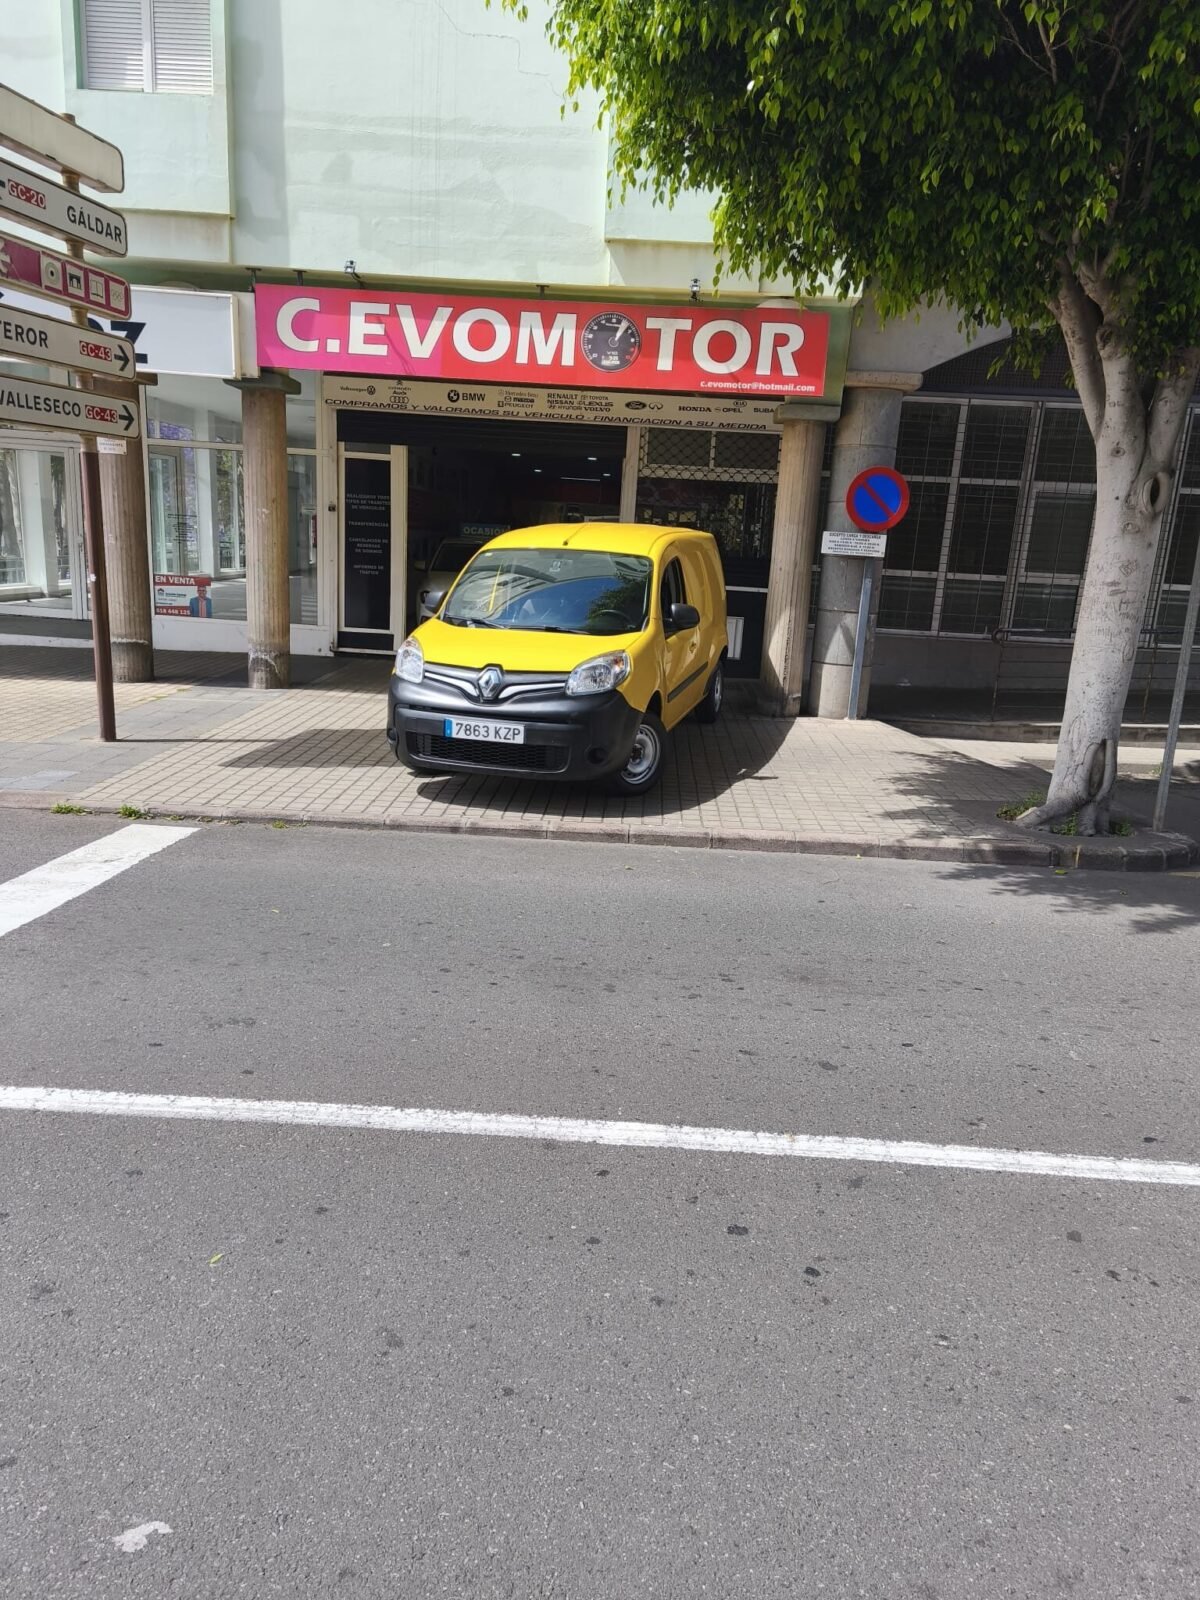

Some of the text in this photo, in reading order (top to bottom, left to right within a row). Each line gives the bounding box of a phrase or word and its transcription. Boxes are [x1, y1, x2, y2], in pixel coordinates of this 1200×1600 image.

[8, 181, 122, 244] GC-20 GÁLDAR
[0, 319, 112, 360] EROR GC-43
[700, 381, 815, 392] c.evomotor@hotmail.com
[462, 393, 485, 401] BMW
[85, 405, 118, 423] GC-43
[325, 398, 408, 410] COMPRAMOS
[423, 404, 500, 416] VALORAMOS
[524, 411, 584, 420] VEHICULO
[593, 415, 681, 425] FINANCIACION
[719, 422, 767, 430] MEDIDA
[155, 575, 195, 585] EN VENTA
[455, 722, 521, 741] 7863 KZP
